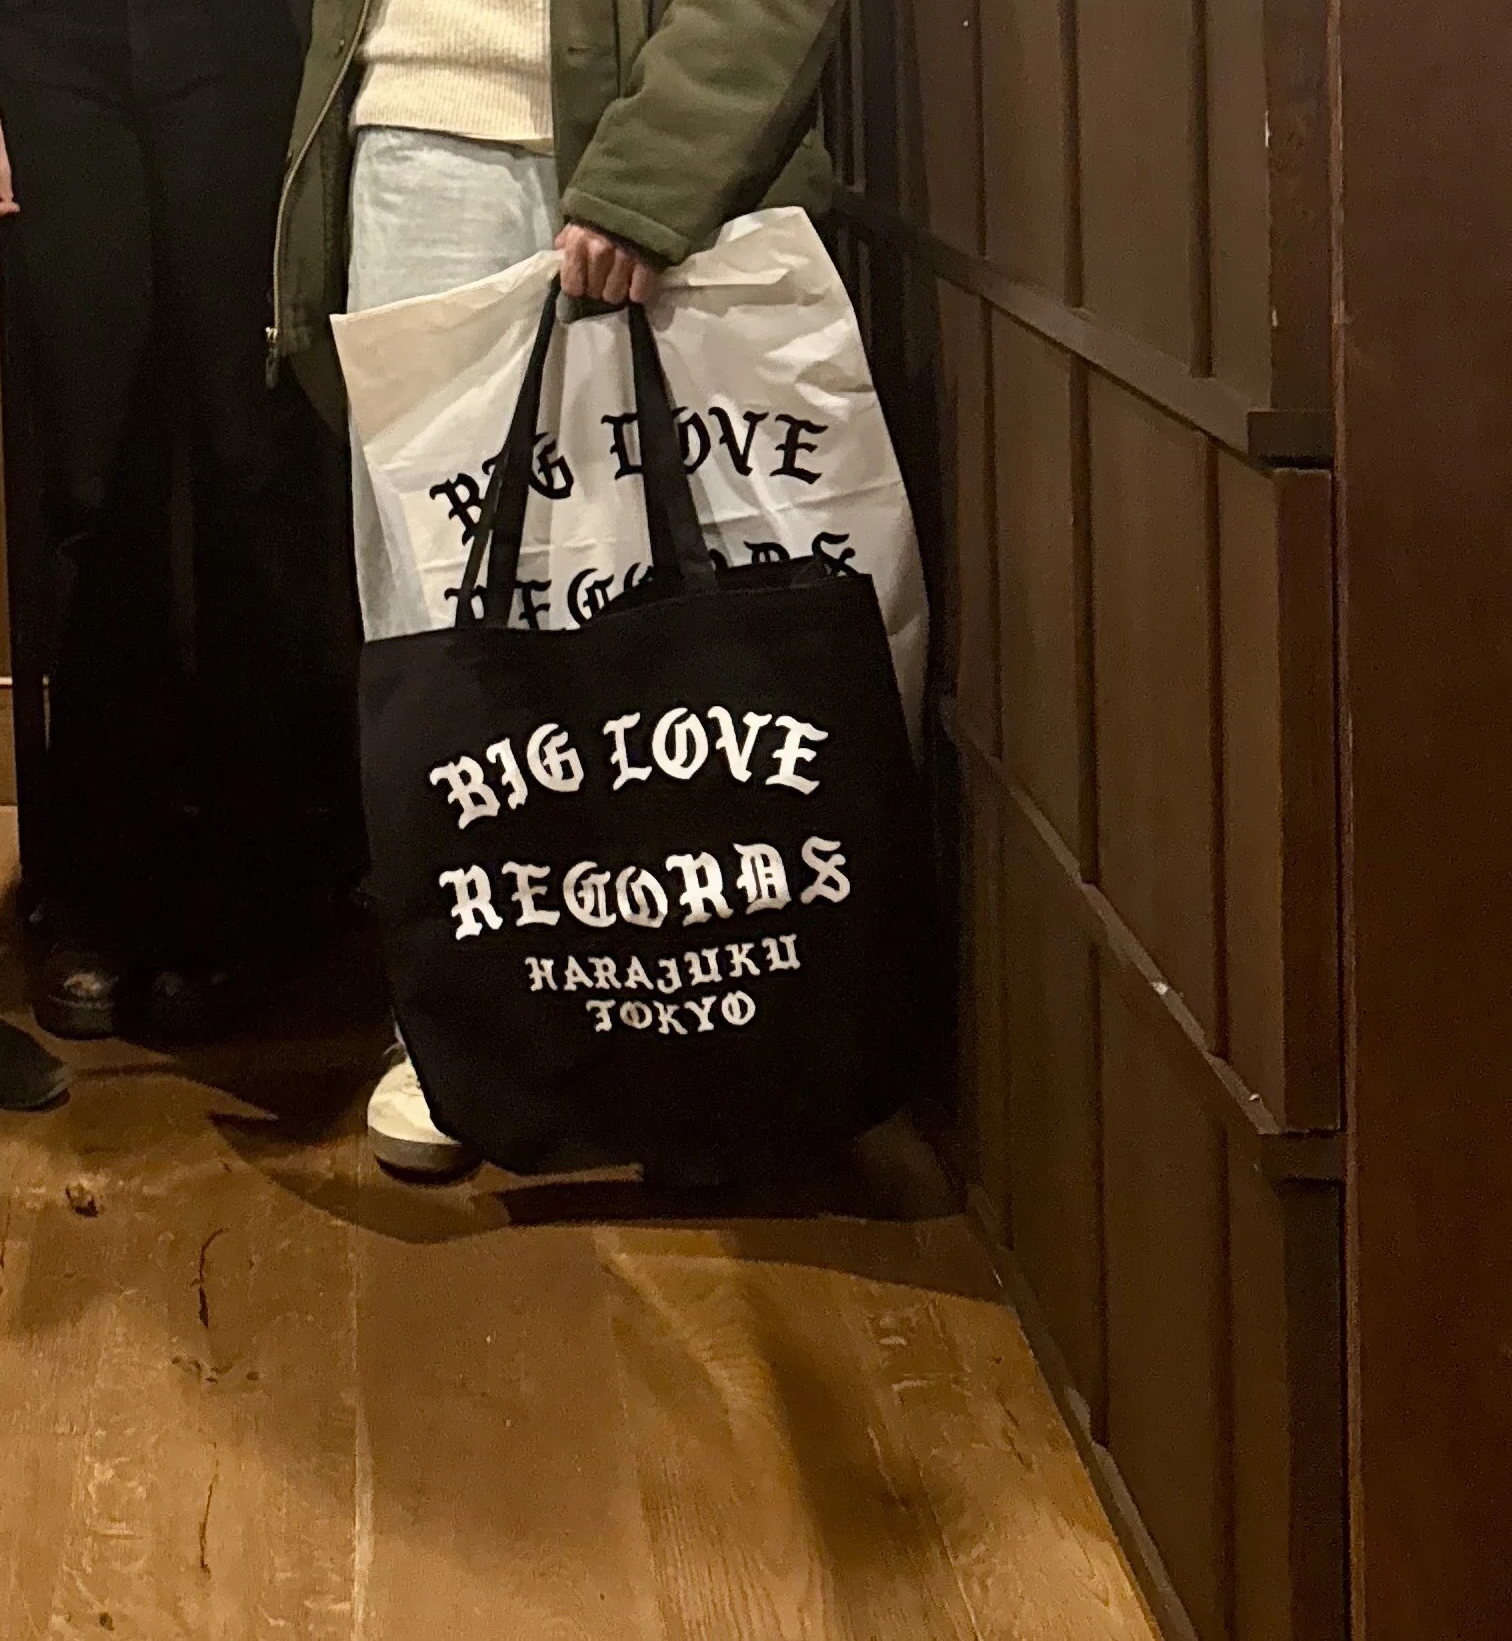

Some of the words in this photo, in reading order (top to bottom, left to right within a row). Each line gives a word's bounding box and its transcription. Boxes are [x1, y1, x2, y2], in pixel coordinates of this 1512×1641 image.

[429, 431, 574, 547] BG
[429, 723, 585, 830] BIG
[602, 705, 830, 796] LOVE
[438, 835, 852, 941] RECORDS
[524, 933, 802, 995] HARAJUKU
[585, 990, 757, 1036] TOKYO
